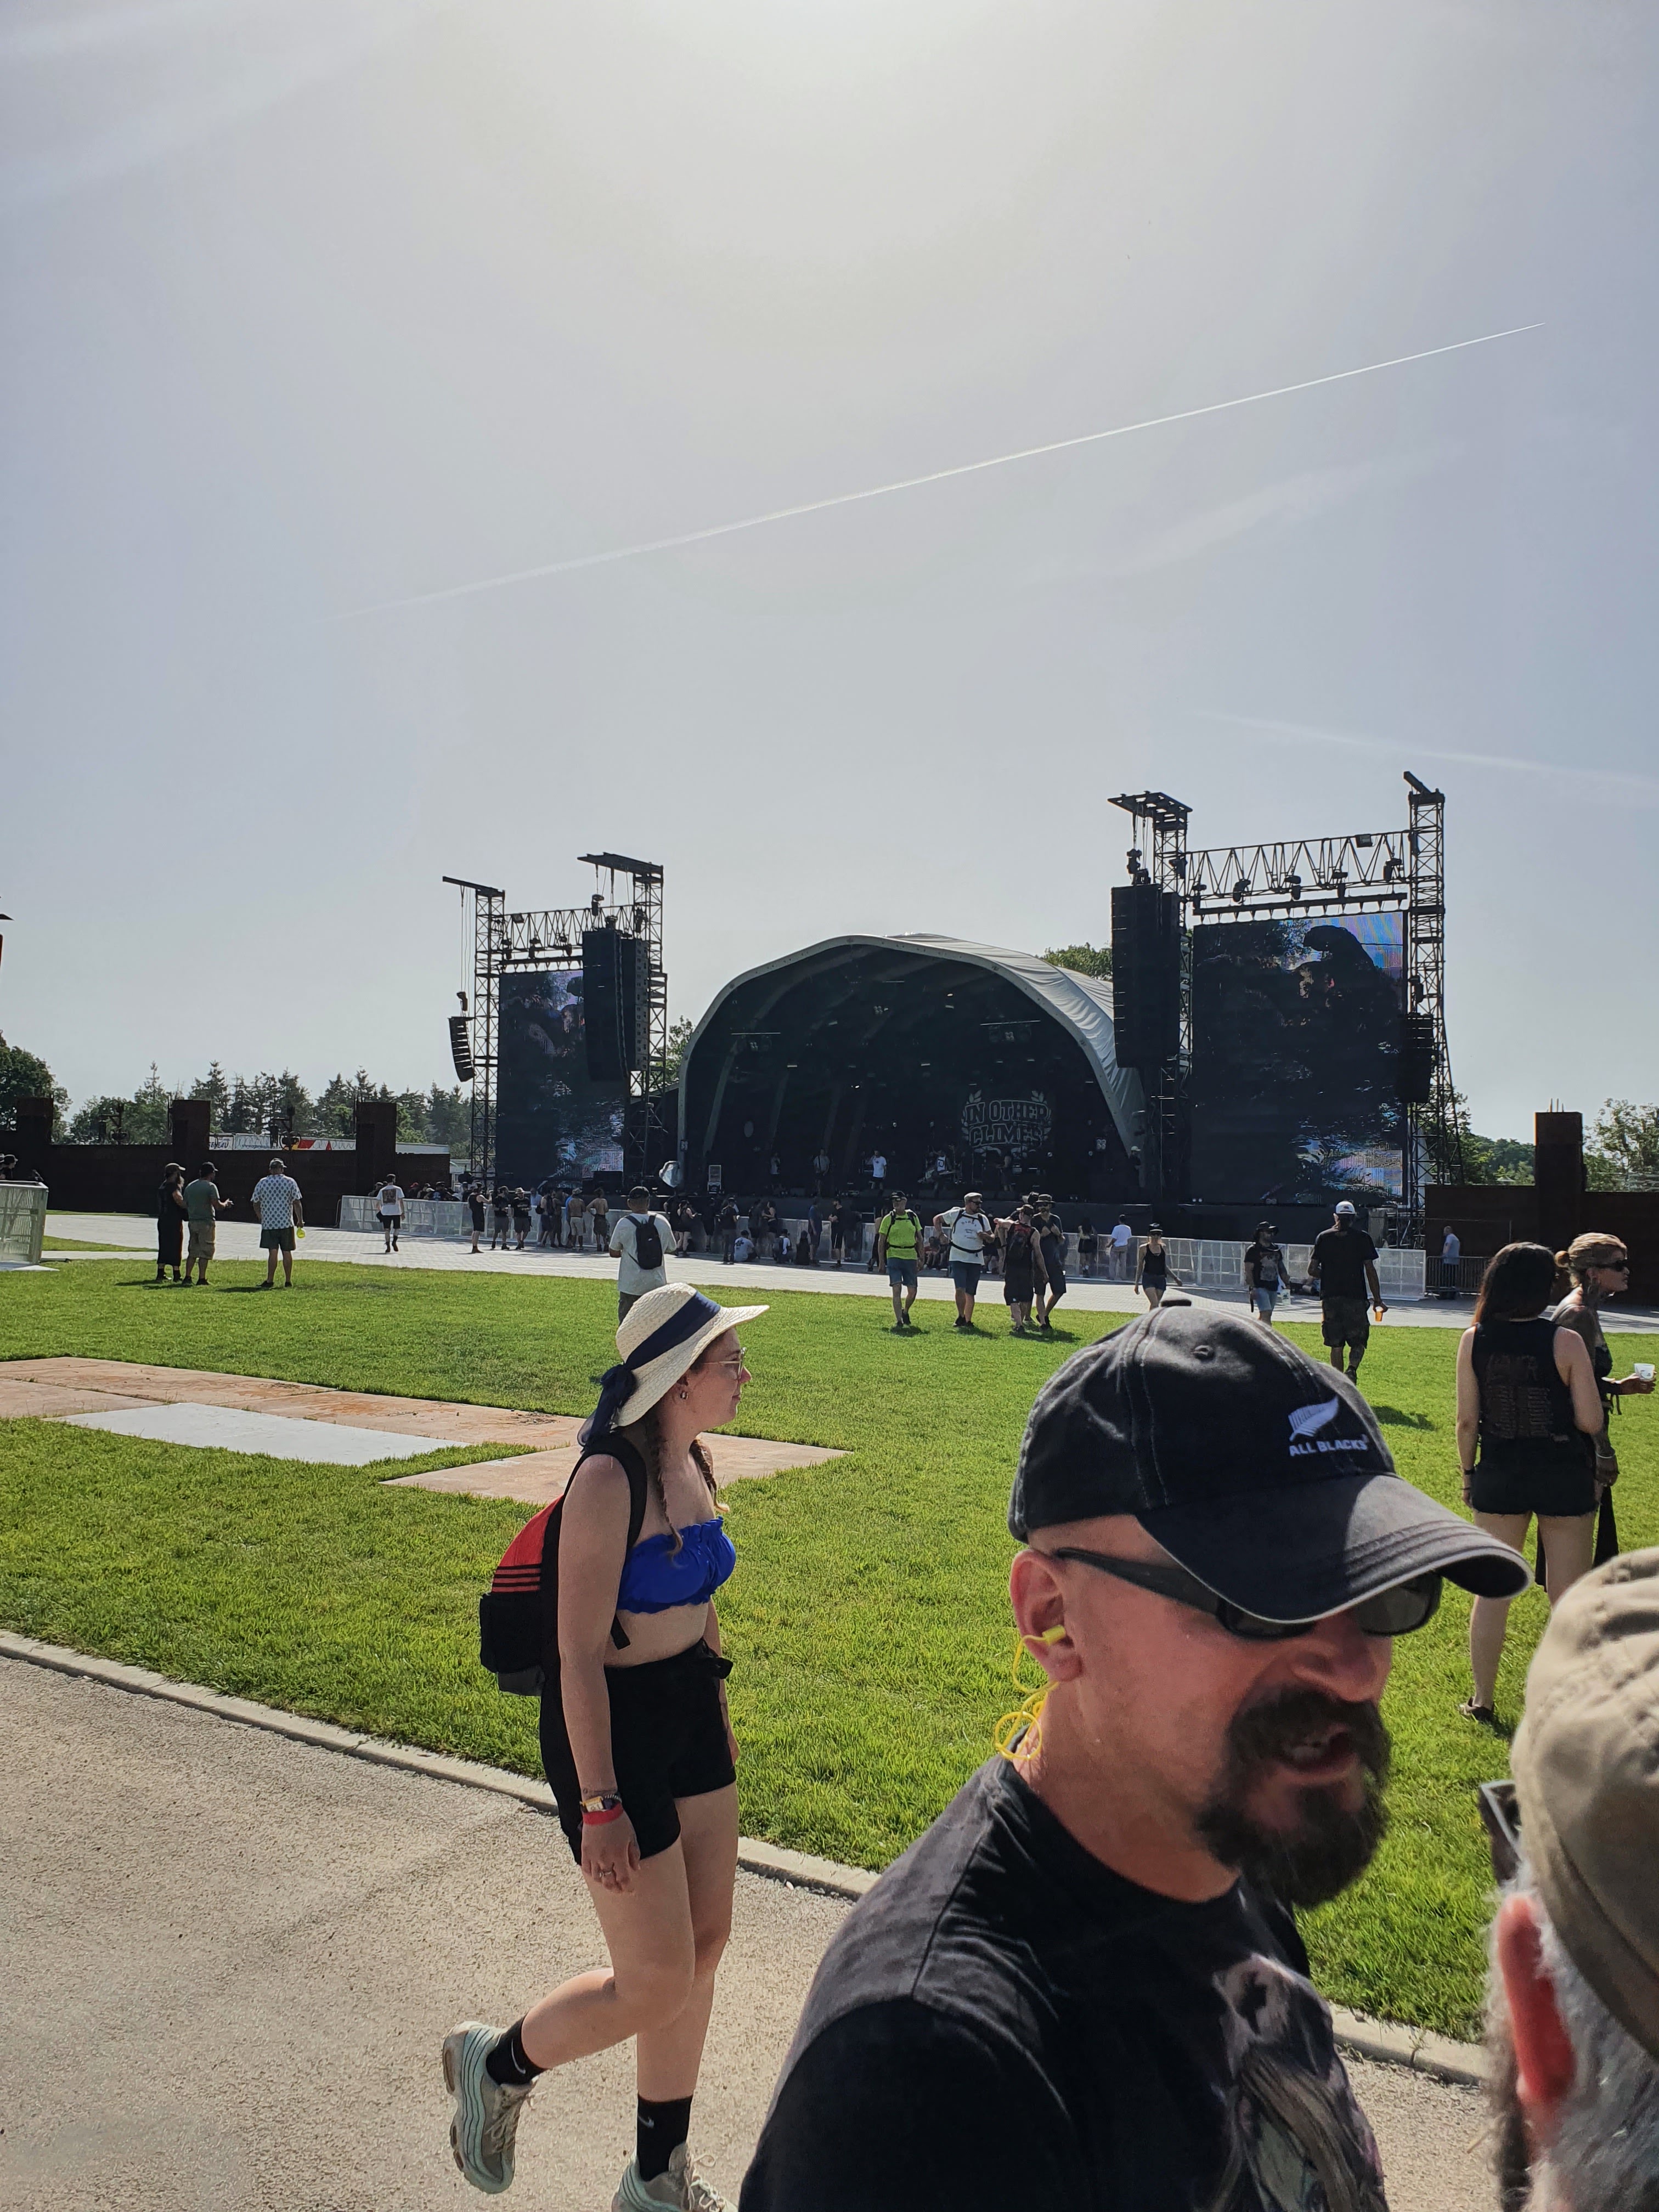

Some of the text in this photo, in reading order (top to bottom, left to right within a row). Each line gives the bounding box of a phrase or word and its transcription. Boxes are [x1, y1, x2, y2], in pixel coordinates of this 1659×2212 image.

[965, 1099, 1049, 1124] IN OTHER
[969, 1124, 1043, 1147] CLIMES
[1289, 1439, 1368, 1457] ALL BLACKS
